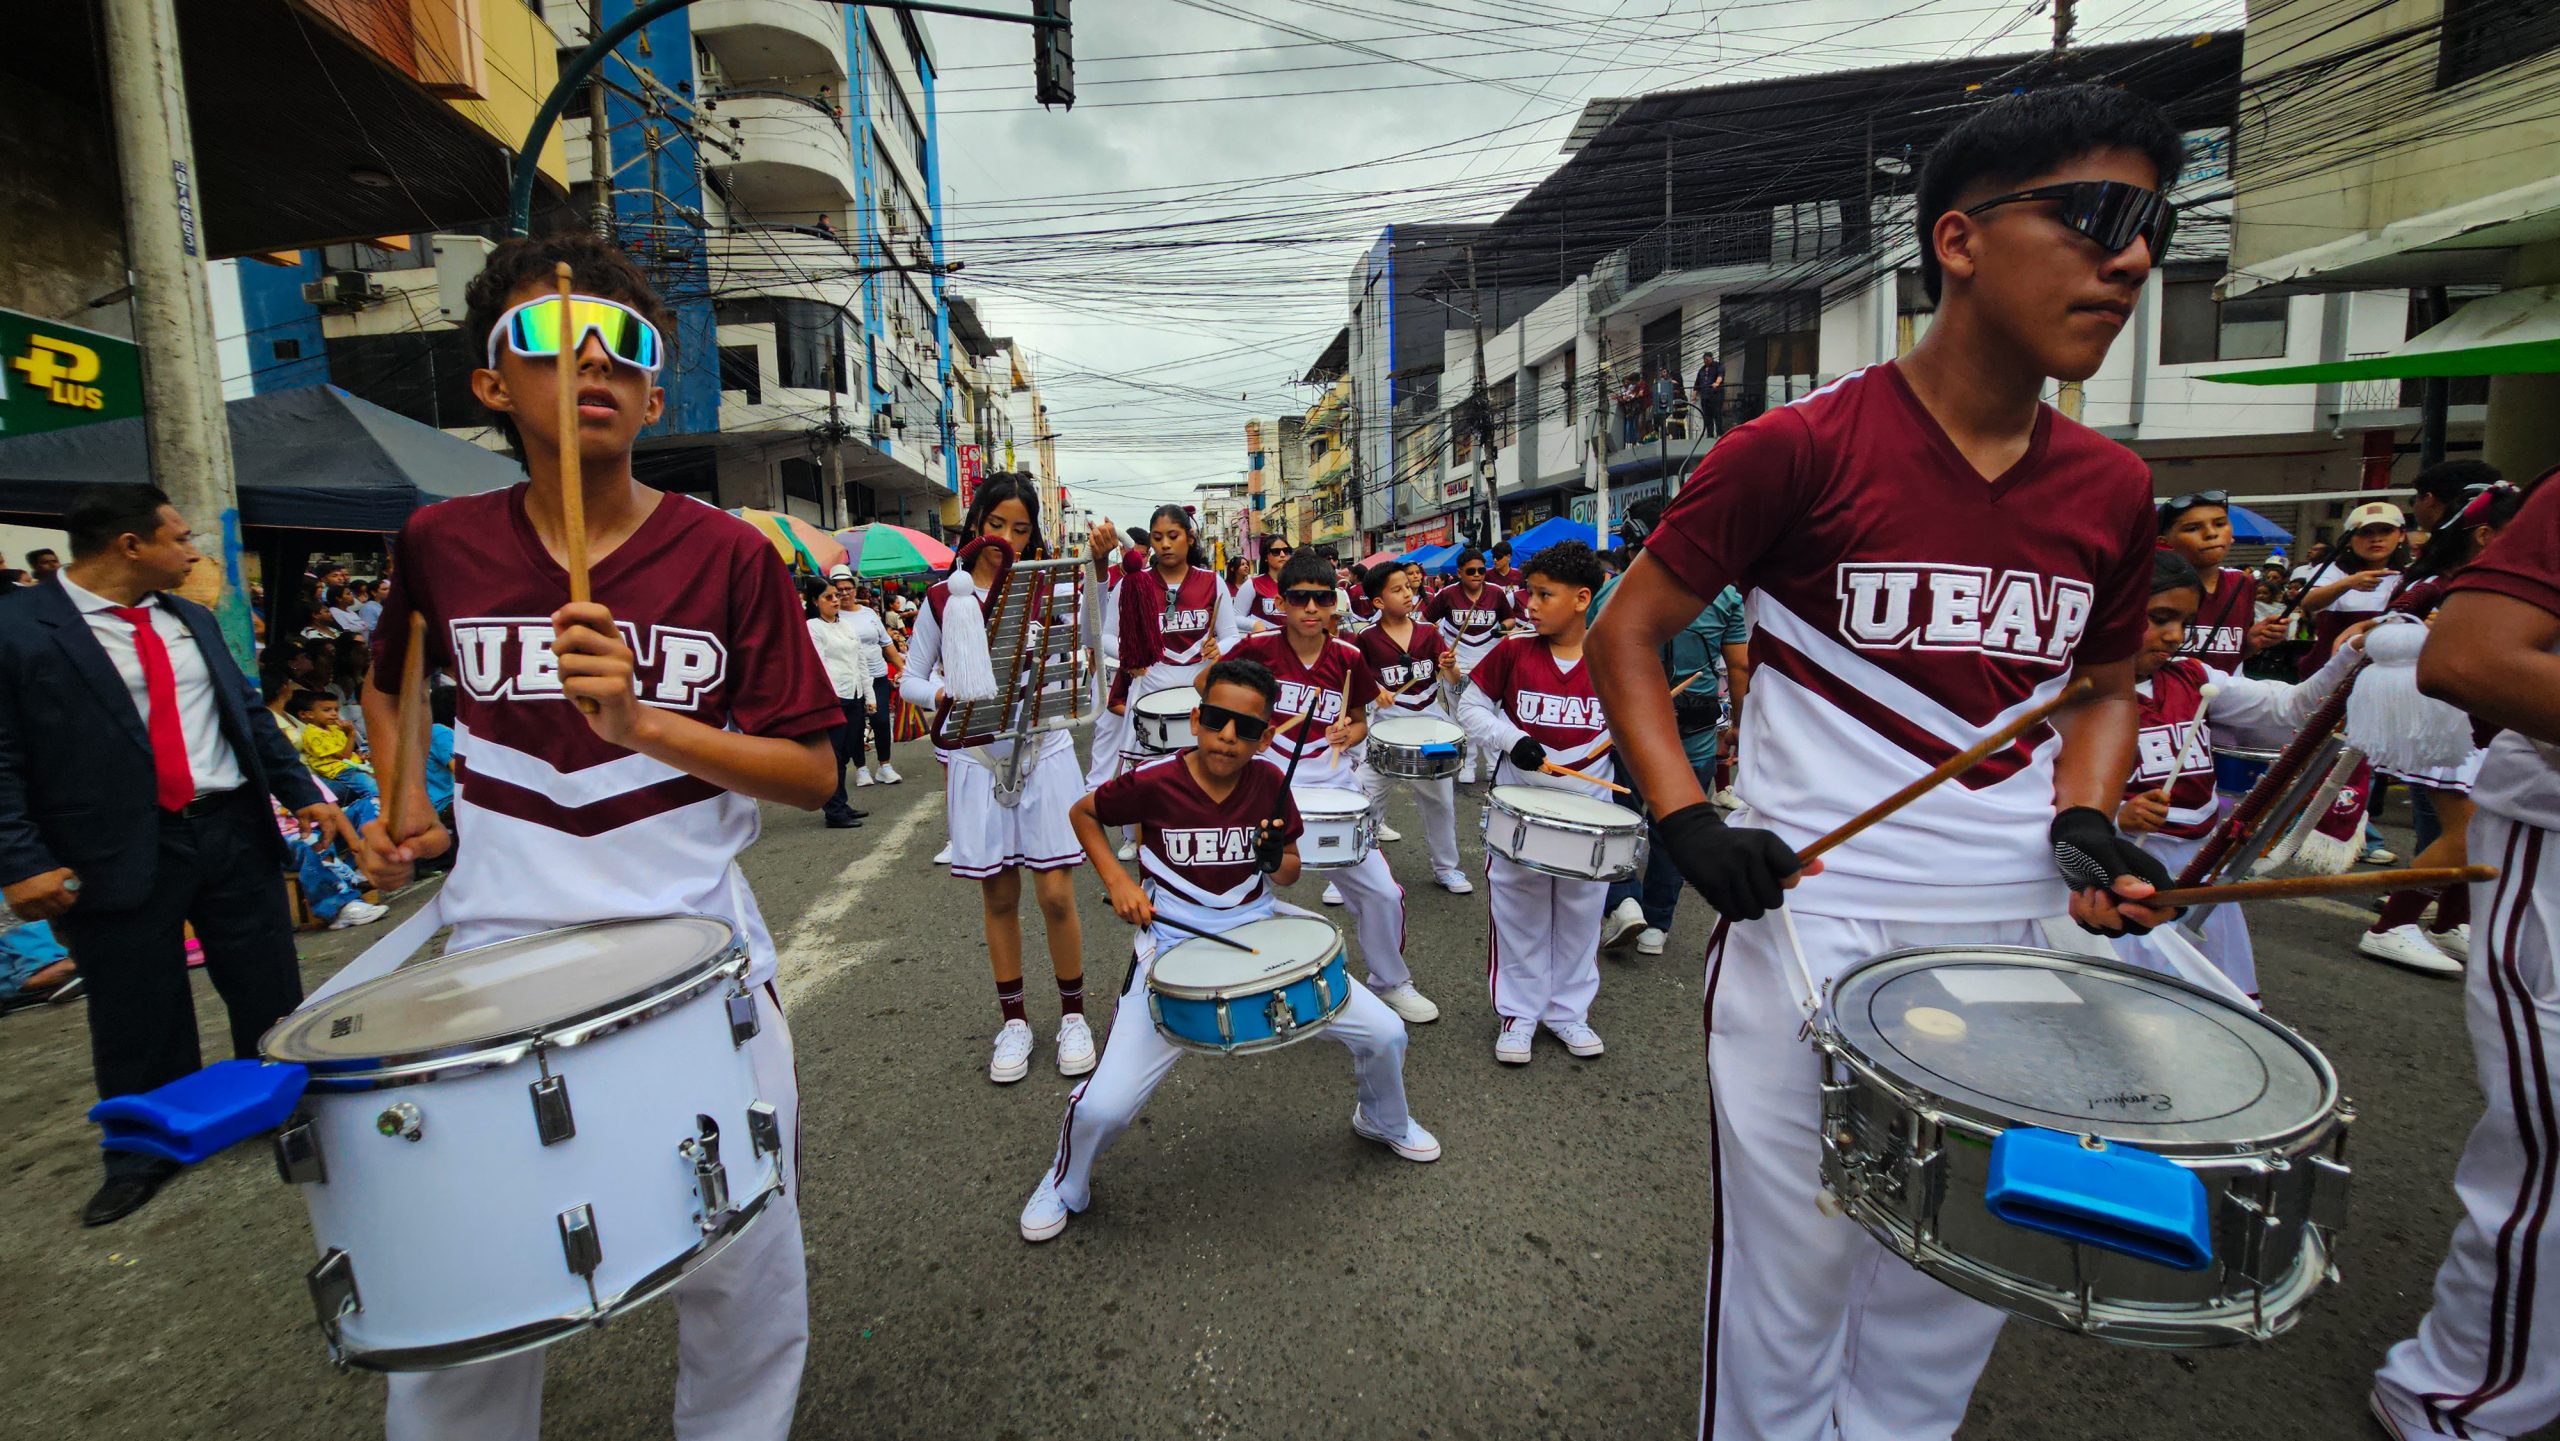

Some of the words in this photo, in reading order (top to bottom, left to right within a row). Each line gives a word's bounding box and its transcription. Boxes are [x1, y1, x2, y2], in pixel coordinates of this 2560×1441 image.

[1159, 609, 1210, 632] EAP
[1838, 563, 2094, 664] UEAP
[450, 618, 727, 709] UEP
[1274, 680, 1344, 723] EAP
